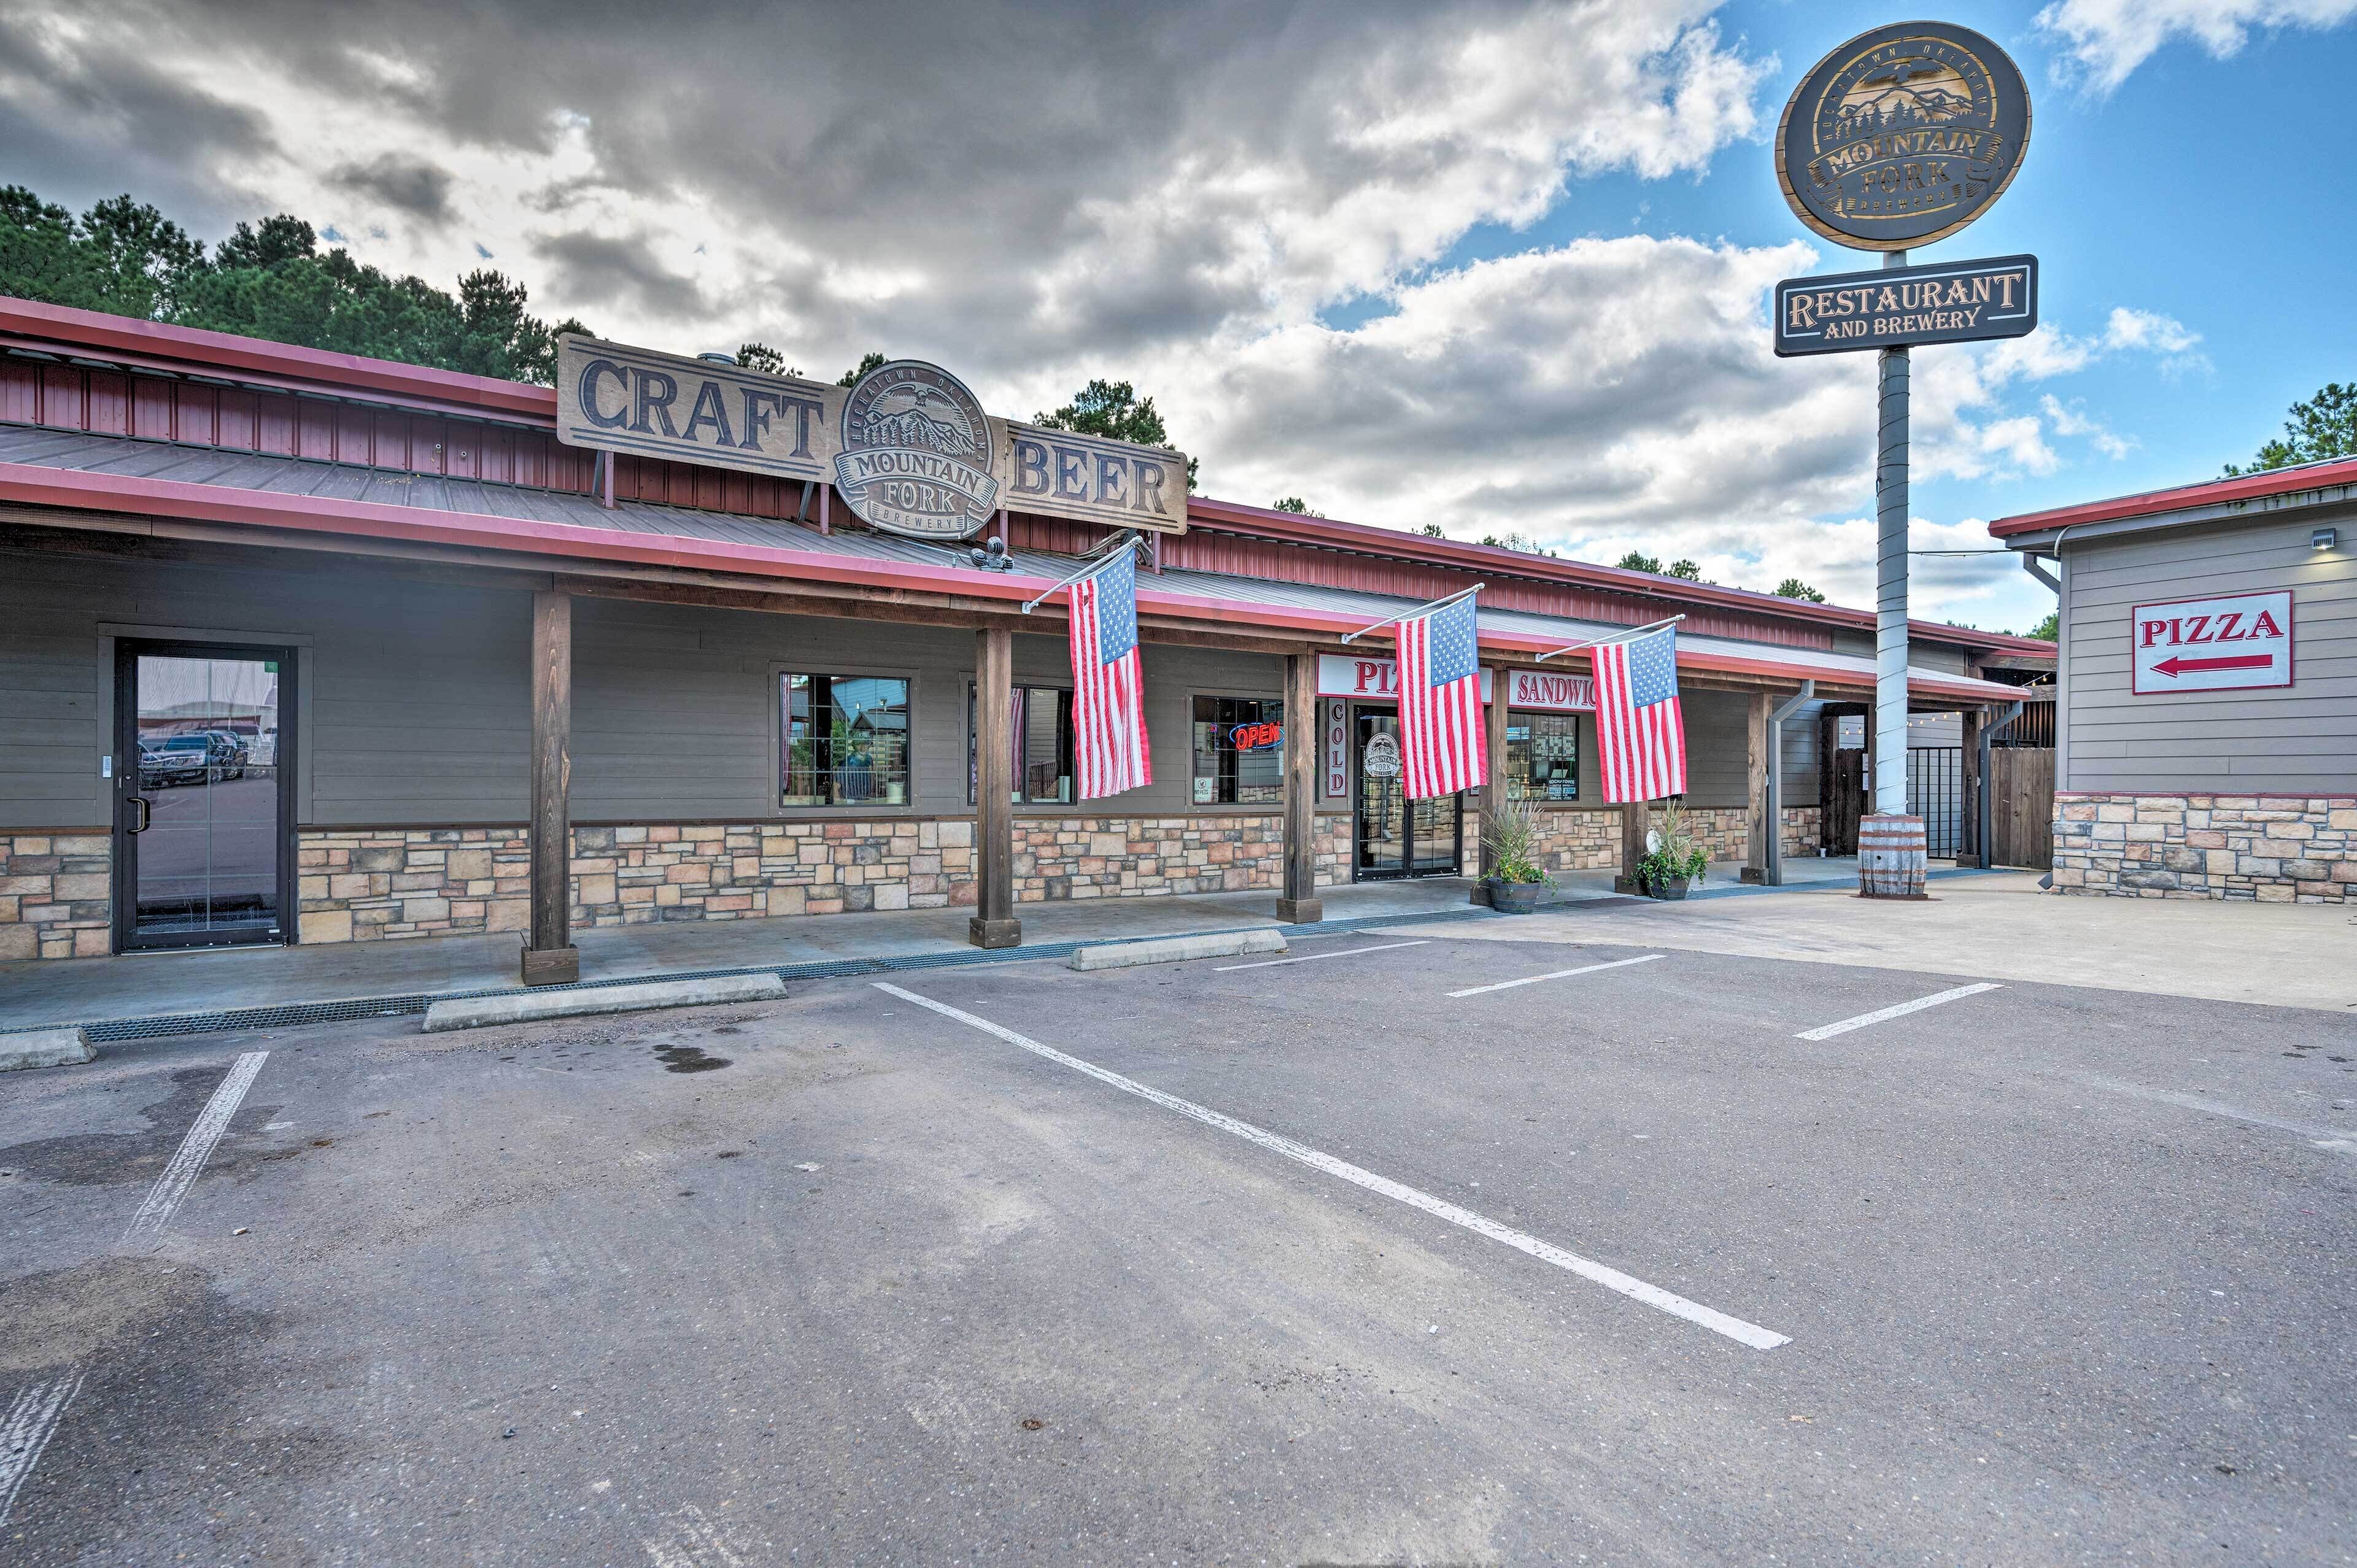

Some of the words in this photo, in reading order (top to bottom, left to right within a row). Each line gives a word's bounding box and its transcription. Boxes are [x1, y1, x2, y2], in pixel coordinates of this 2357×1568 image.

[1825, 130, 1981, 175] MOUNTAIN
[1860, 161, 1950, 193] FORK
[1860, 191, 1945, 211] BREWERY
[1790, 273, 2023, 329] RESTAURANT
[1824, 320, 1868, 339] AND
[1873, 306, 1982, 335] BREWERY
[851, 370, 916, 441] HOCHATOWN
[937, 379, 986, 461] OKLAHOMA
[579, 359, 825, 460] CRAFT
[1009, 437, 1167, 515] BEER
[854, 452, 981, 495] MOUNTAIN
[883, 481, 956, 512] FORK
[883, 509, 953, 530] BREWERY
[2140, 609, 2285, 648] PIZZA
[1354, 661, 1399, 694] PI
[1236, 721, 1280, 751] OPEN
[1331, 704, 1344, 791] COLD
